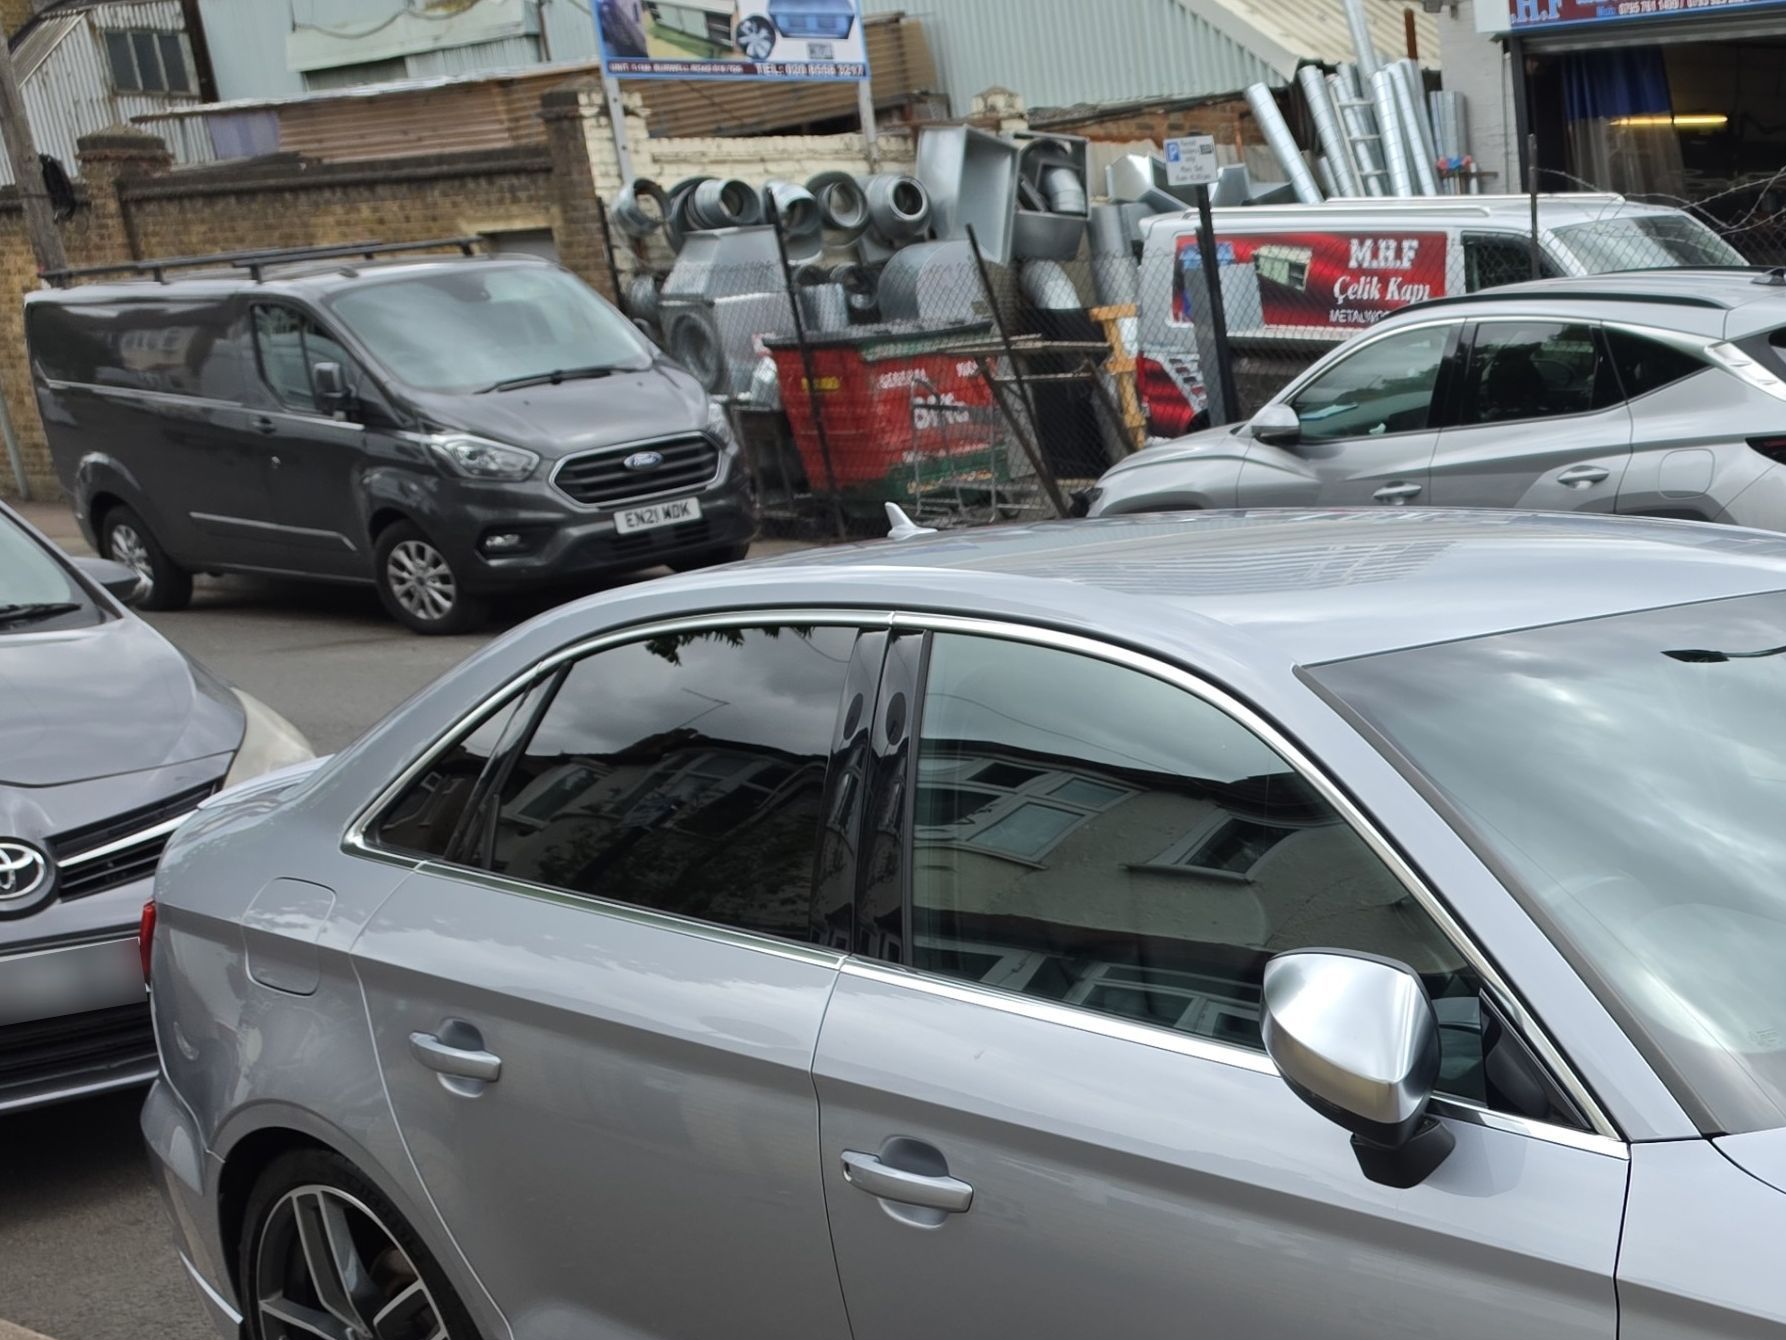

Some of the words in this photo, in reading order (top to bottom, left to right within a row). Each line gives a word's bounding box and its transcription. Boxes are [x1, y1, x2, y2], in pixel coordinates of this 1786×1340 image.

[1348, 238, 1419, 269] M.H.F
[1333, 276, 1382, 304] Çelik
[624, 508, 660, 528] EN21
